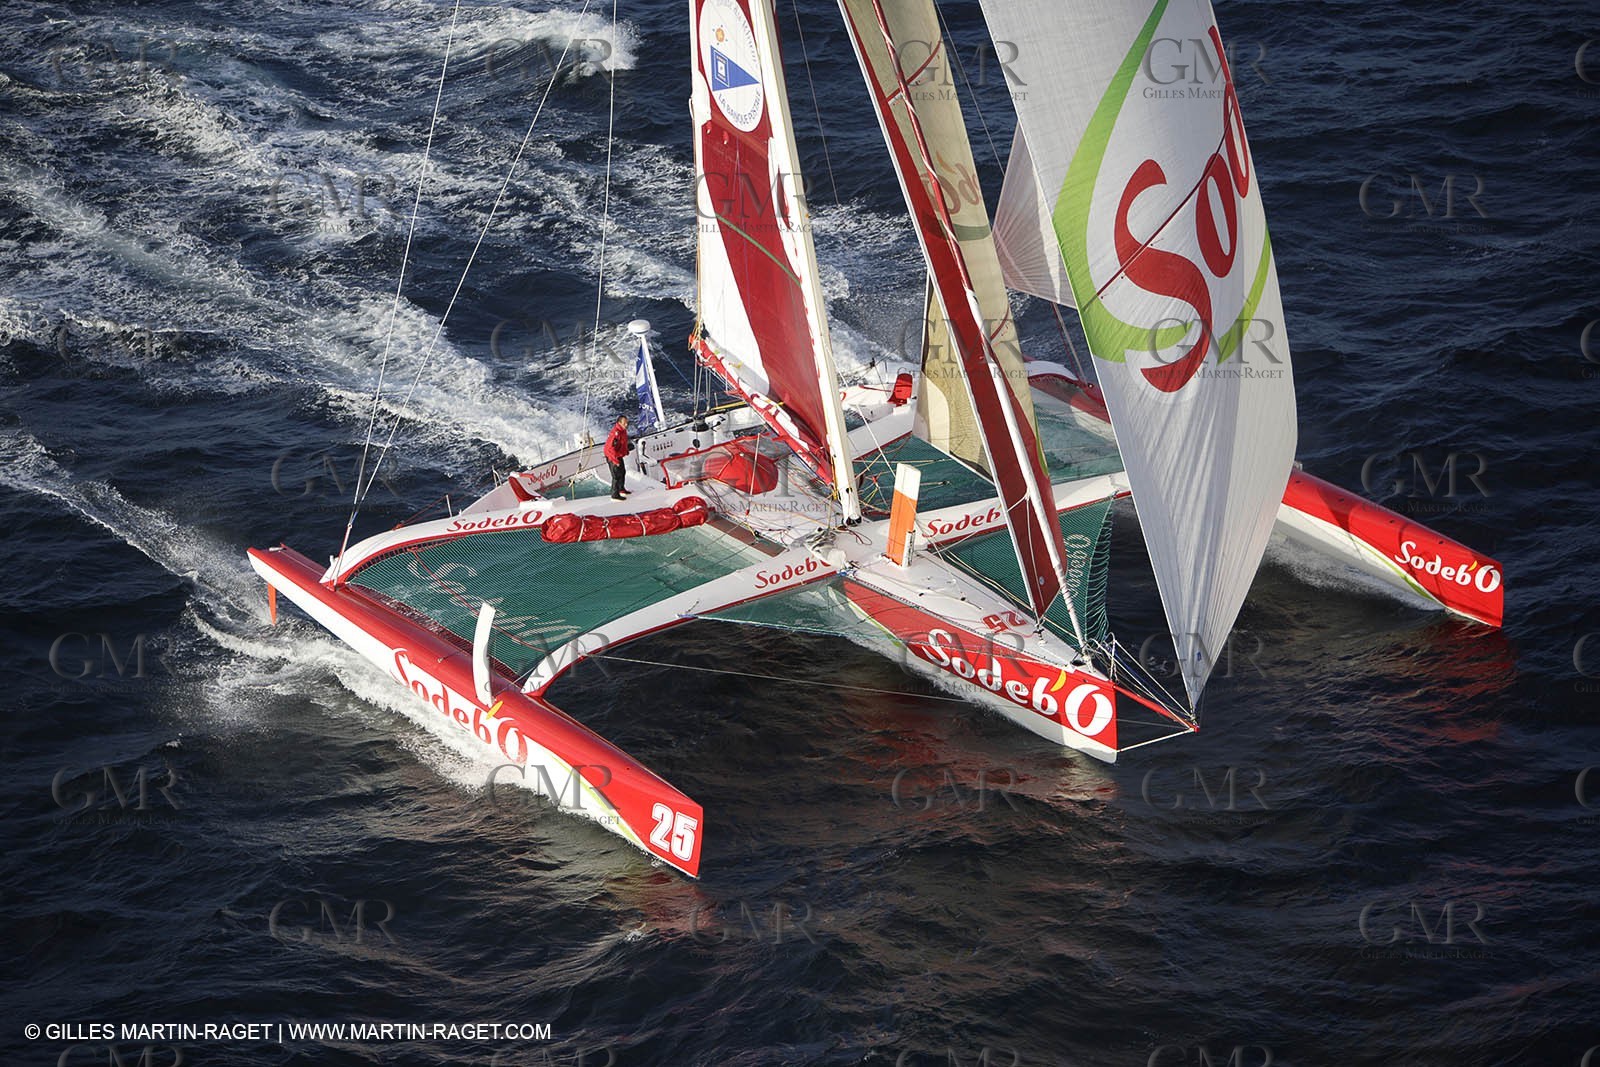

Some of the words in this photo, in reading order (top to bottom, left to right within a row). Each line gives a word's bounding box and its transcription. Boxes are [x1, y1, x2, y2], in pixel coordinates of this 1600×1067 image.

[1394, 541, 1501, 593] Sodeb'O
[922, 628, 1113, 736] Sodeb'O
[649, 802, 698, 862] 25
